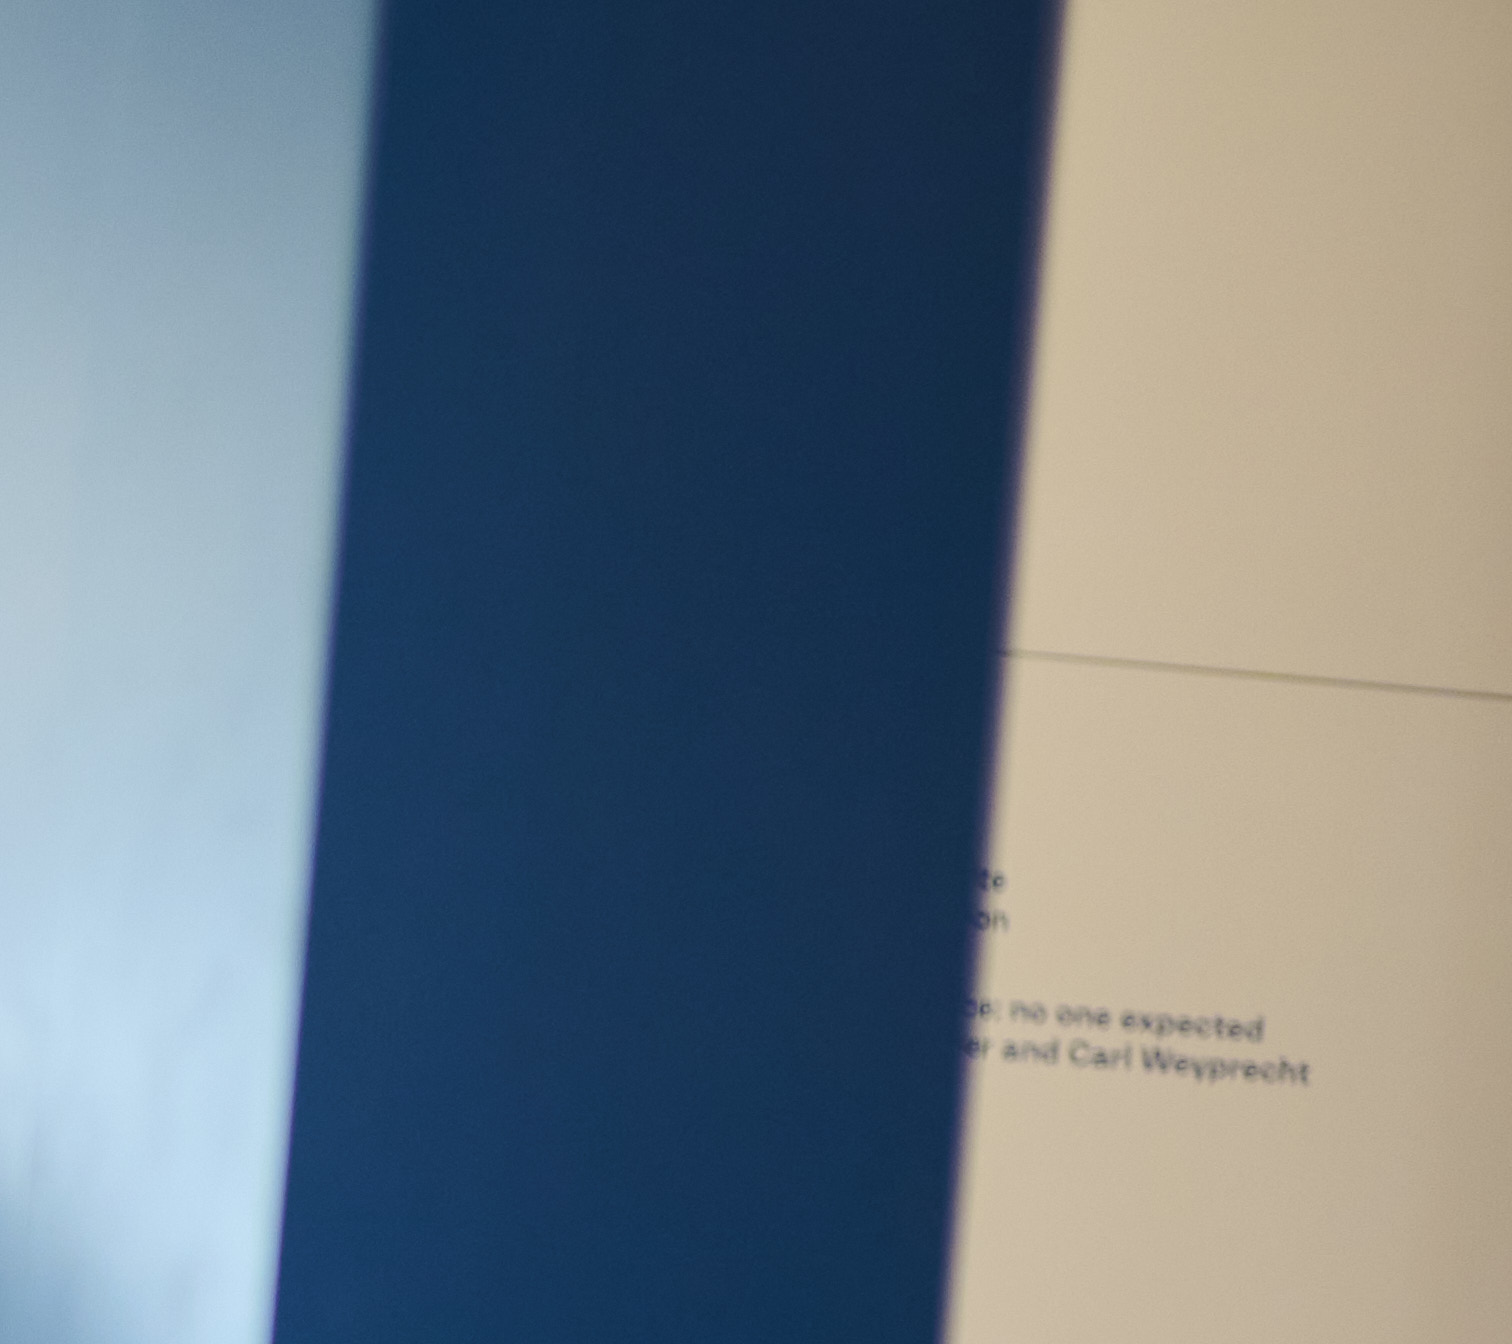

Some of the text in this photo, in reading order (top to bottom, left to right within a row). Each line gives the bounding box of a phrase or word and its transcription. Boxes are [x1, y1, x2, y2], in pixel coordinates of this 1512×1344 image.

[1010, 1001, 1048, 1025] no
[1055, 1005, 1111, 1030] one
[1120, 1010, 1266, 1044] expected
[1002, 1038, 1060, 1065] and
[1068, 1038, 1133, 1071] Carl
[1141, 1046, 1312, 1087] Weyprecht
